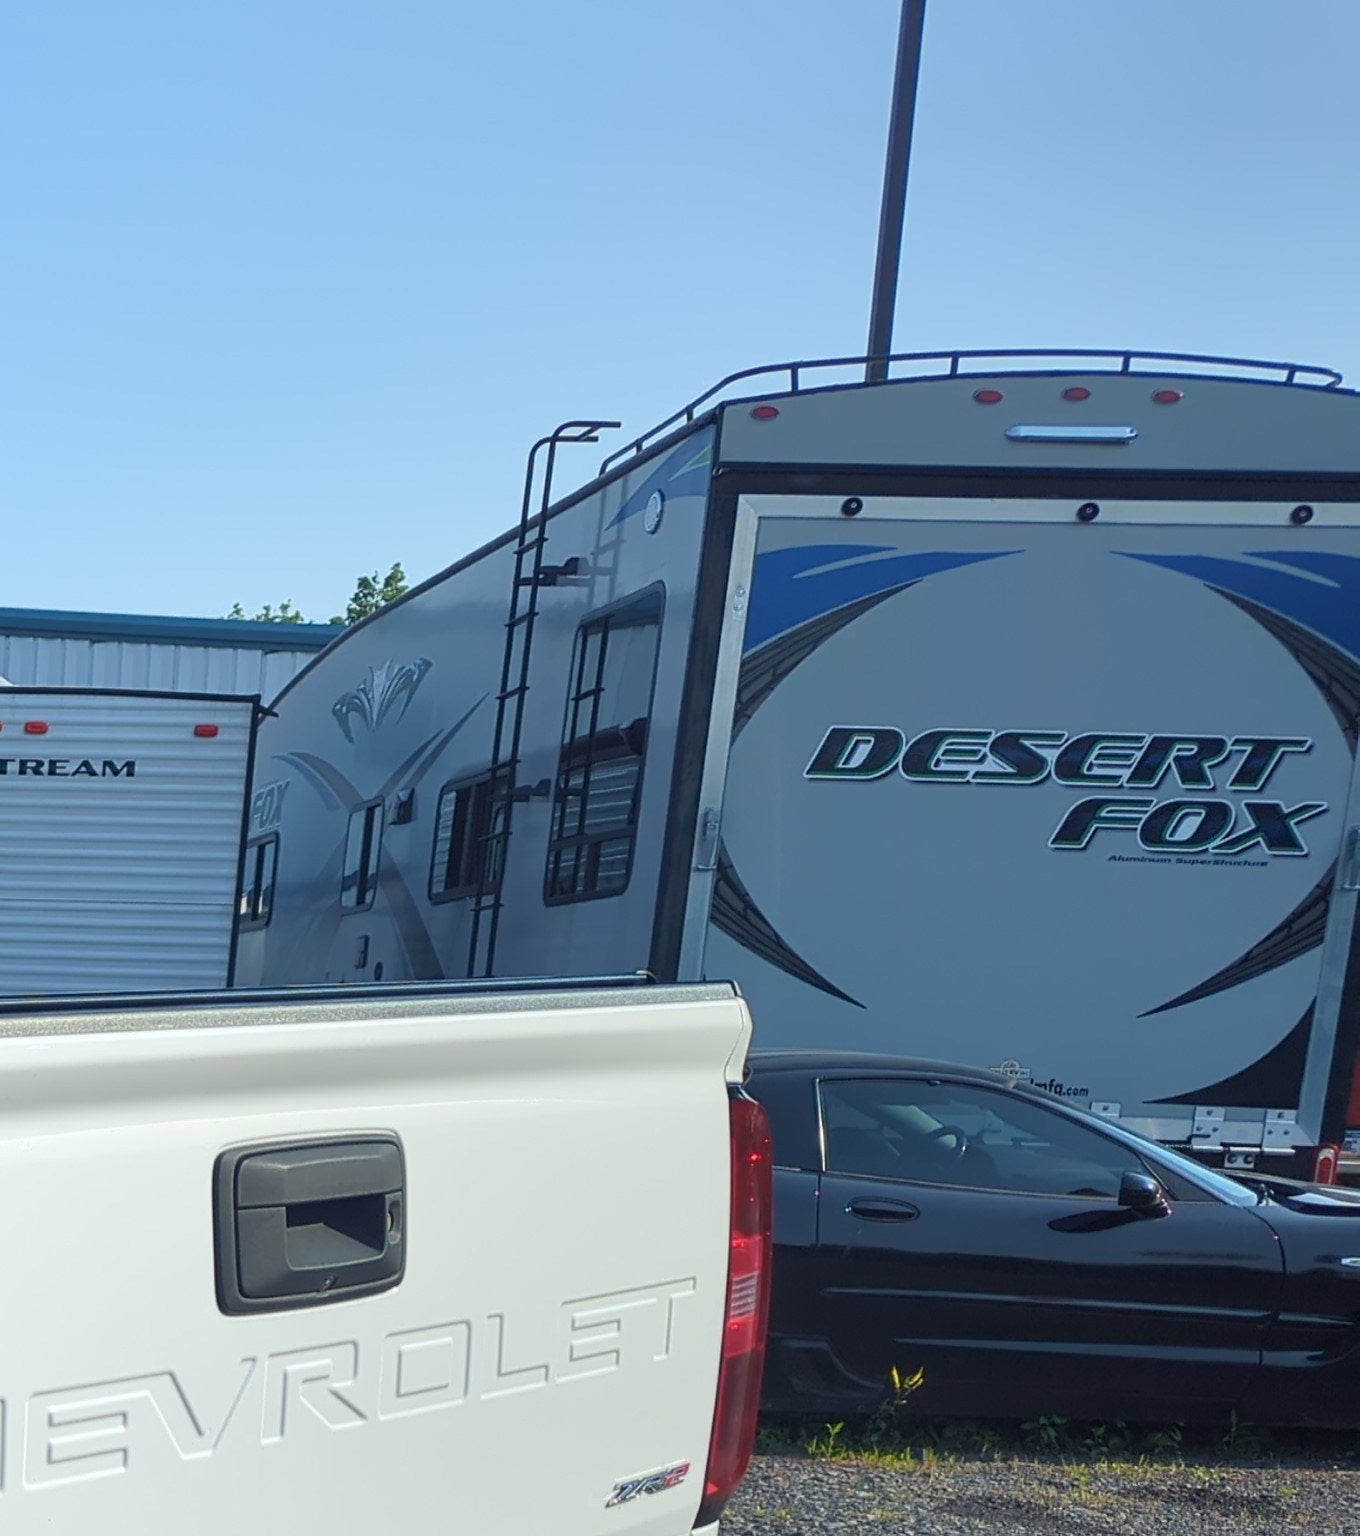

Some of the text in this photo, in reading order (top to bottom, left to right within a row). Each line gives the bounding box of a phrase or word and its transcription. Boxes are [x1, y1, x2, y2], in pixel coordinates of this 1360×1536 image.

[803, 725, 1315, 792] DESERT
[1048, 796, 1330, 857] FOX
[603, 1458, 691, 1509] ZR2
